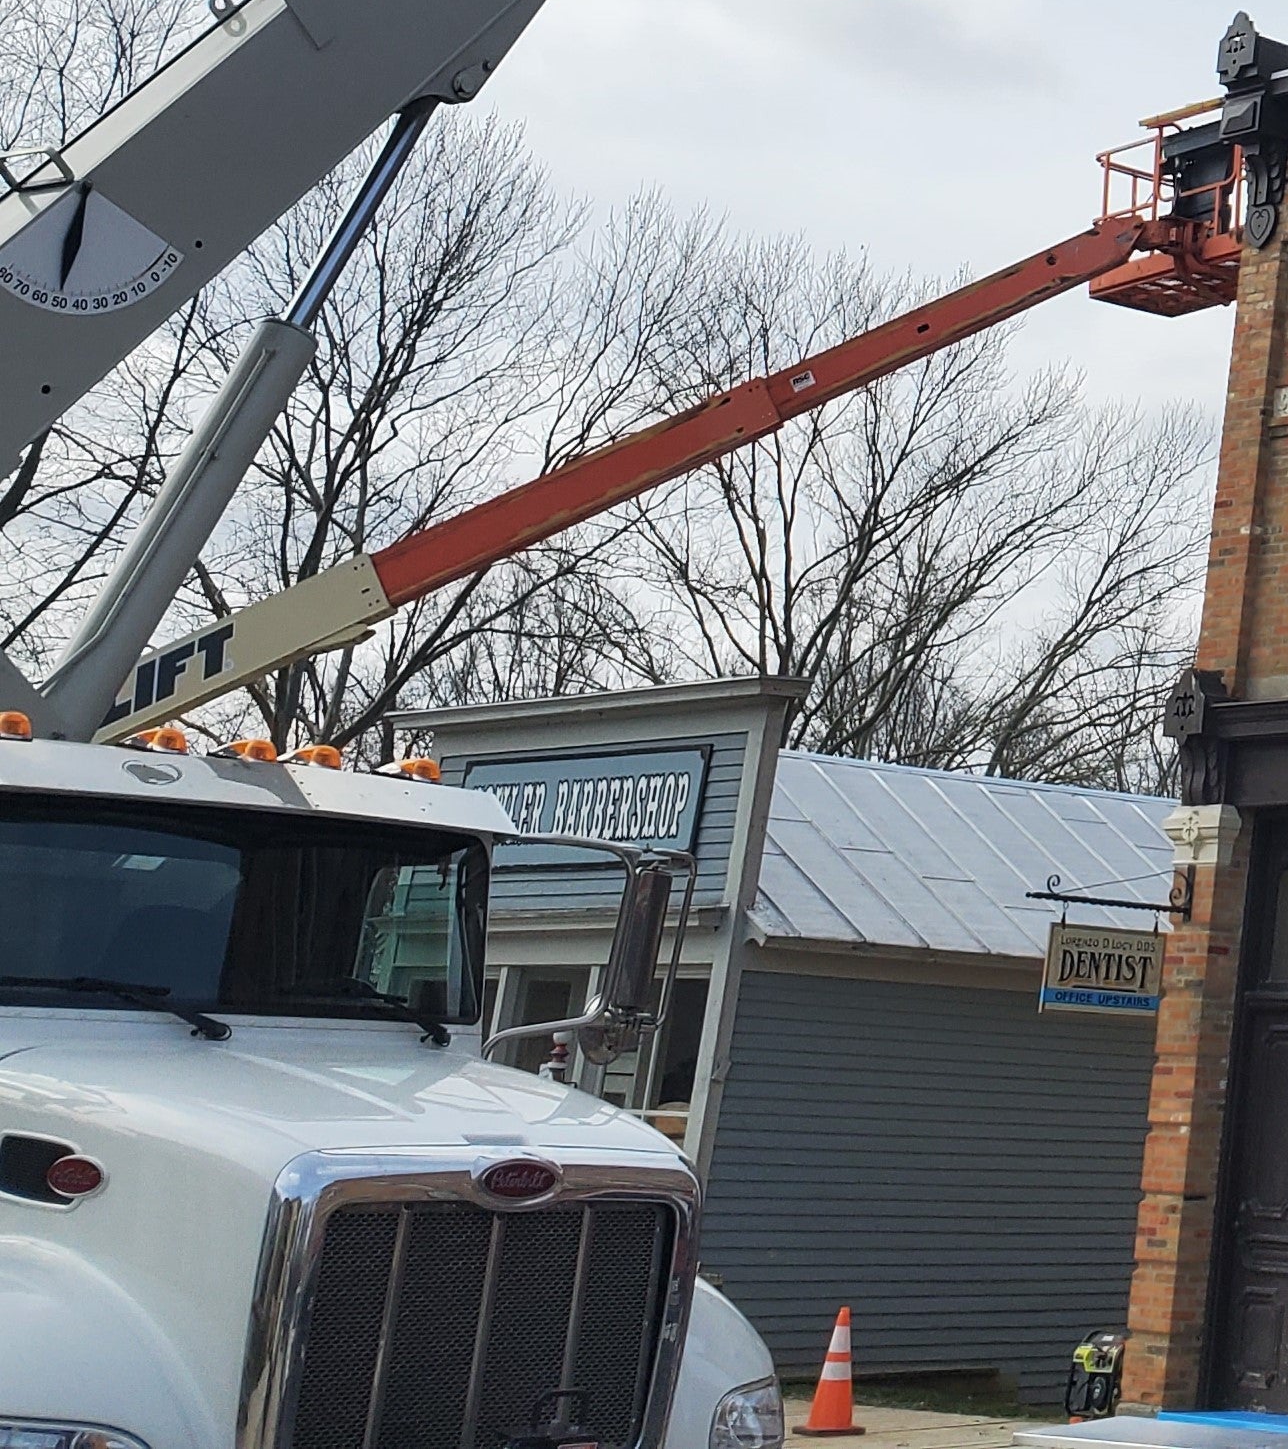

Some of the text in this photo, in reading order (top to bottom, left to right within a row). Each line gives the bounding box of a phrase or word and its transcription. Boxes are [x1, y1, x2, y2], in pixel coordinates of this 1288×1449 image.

[15, 279, 30, 296] 70
[31, 290, 48, 303] 60
[51, 296, 67, 309] 50
[72, 298, 88, 311] 40
[93, 296, 108, 309] 30
[112, 291, 128, 305] 20
[130, 282, 146, 296] 10
[151, 271, 160, 282] 0
[161, 252, 178, 273] -10
[552, 772, 691, 841] BARBERSHOP
[1058, 949, 1154, 988] DENTIST
[1055, 991, 1150, 1007] OFFICE UPSTAIRS
